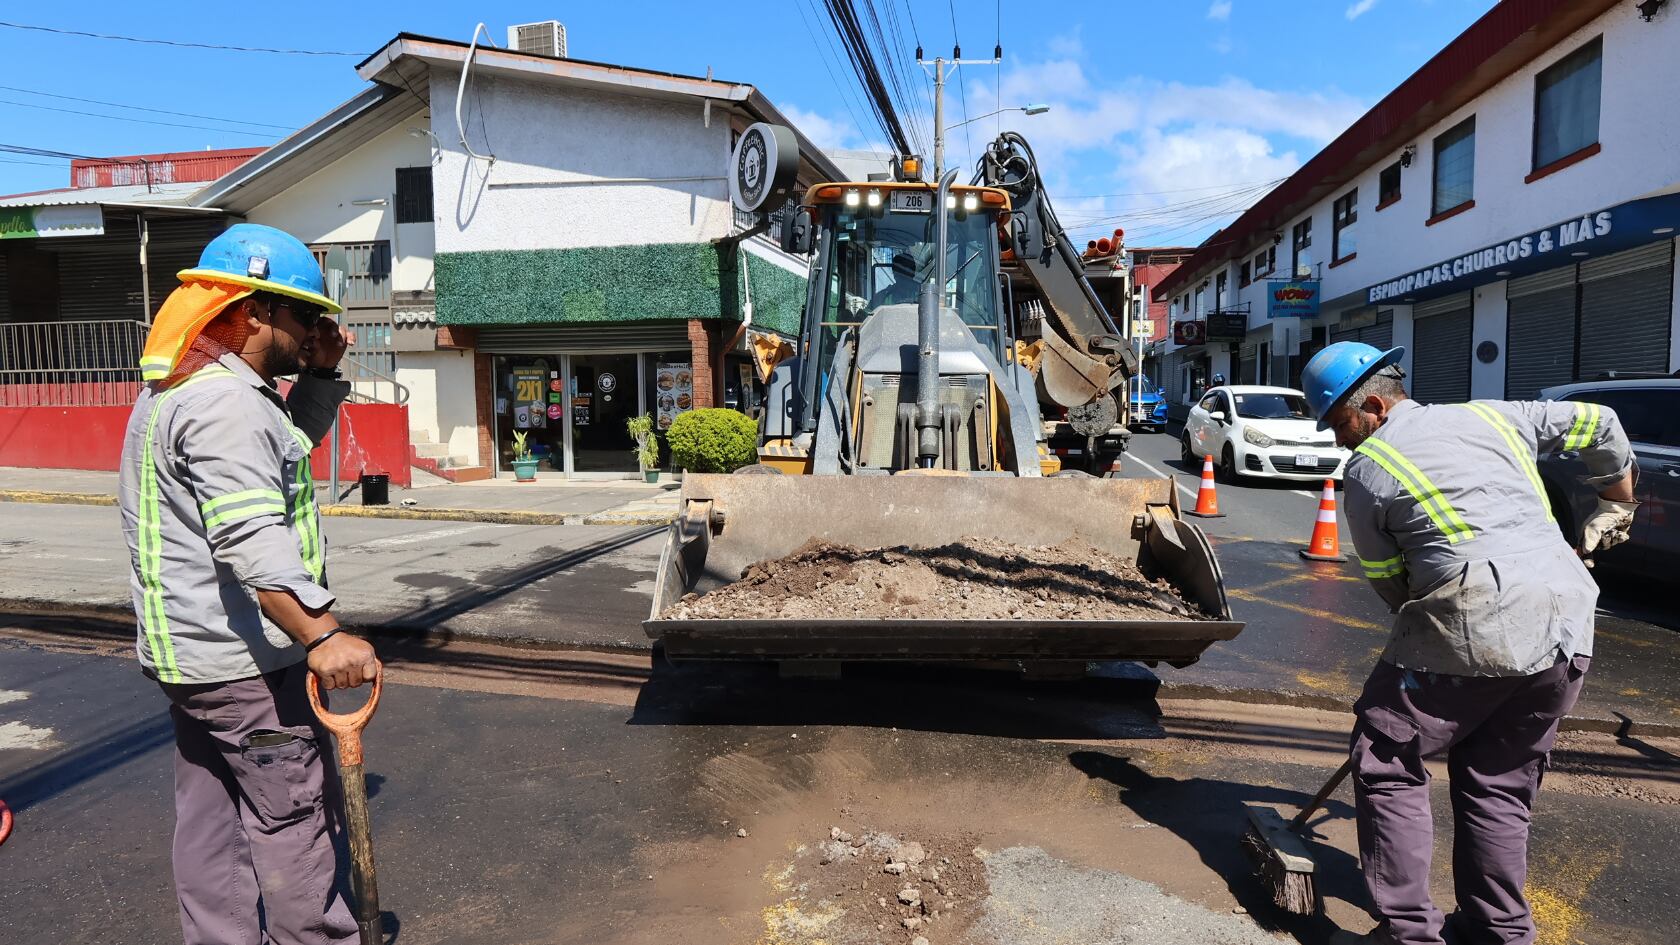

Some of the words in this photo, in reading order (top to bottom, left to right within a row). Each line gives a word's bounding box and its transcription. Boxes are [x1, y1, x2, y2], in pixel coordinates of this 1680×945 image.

[905, 195, 923, 207] 206
[1537, 230, 1553, 252] &
[1559, 211, 1613, 247] MÁS
[516, 380, 543, 401] 2X1
